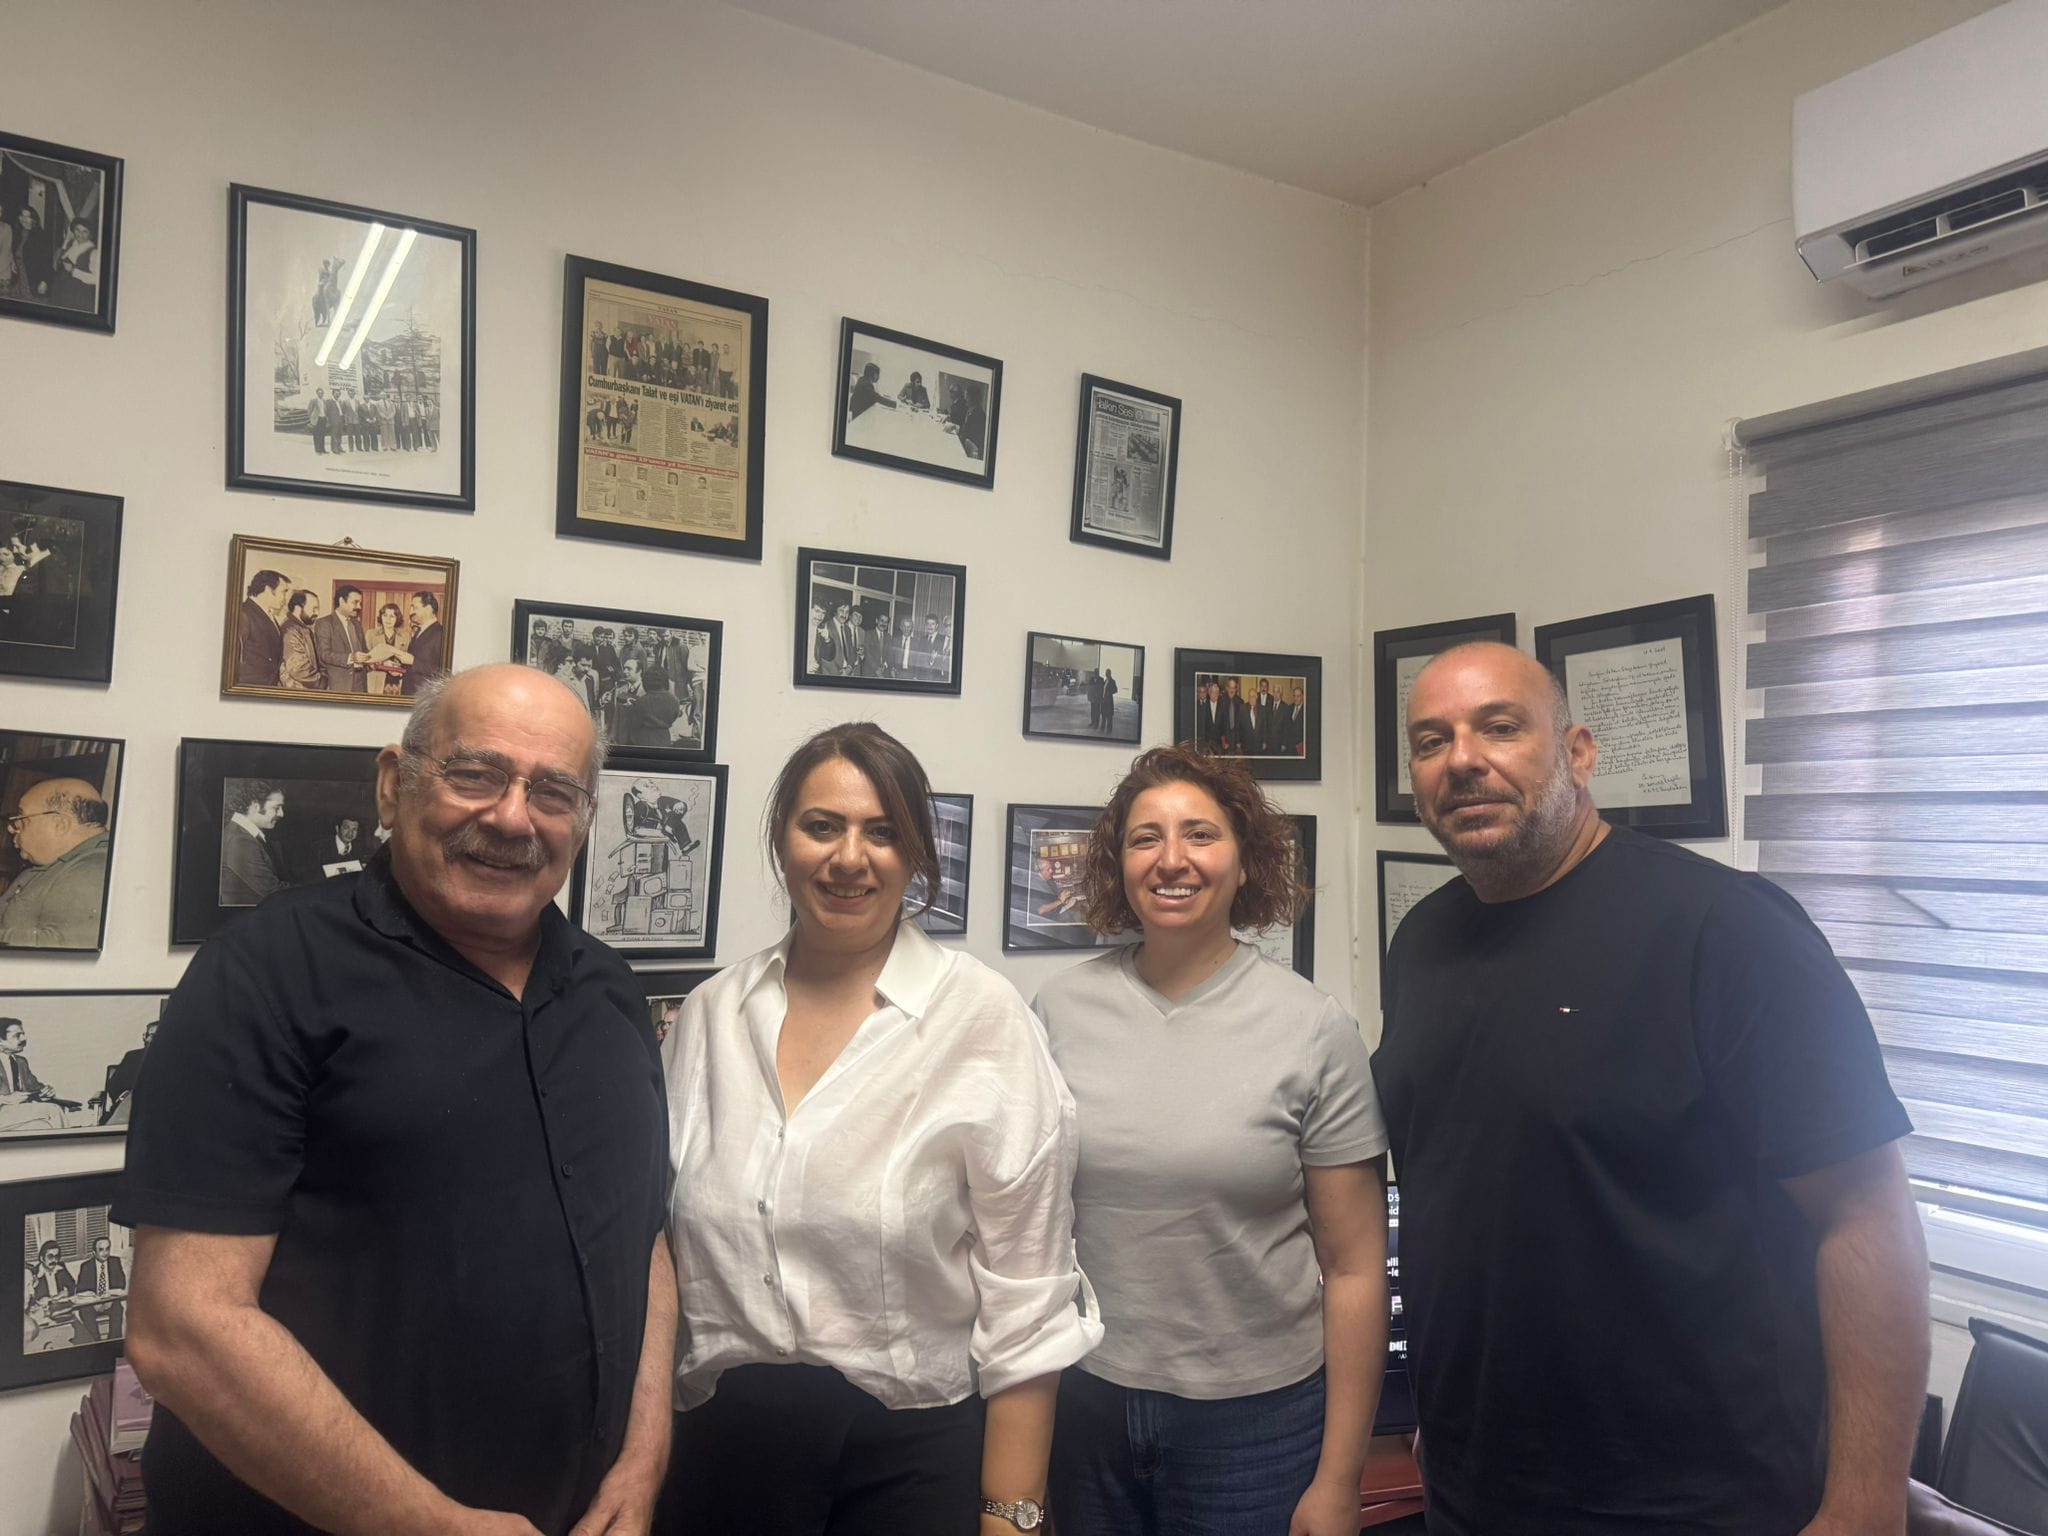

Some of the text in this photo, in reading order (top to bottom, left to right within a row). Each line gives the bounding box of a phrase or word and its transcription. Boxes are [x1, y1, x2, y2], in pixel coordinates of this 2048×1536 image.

[587, 374, 641, 396] Cumhurbaşkanı
[641, 384, 658, 398] Talat
[659, 391, 668, 401] ve
[669, 390, 680, 406] eşi
[705, 396, 727, 413] ziyaret
[727, 401, 739, 414] etti
